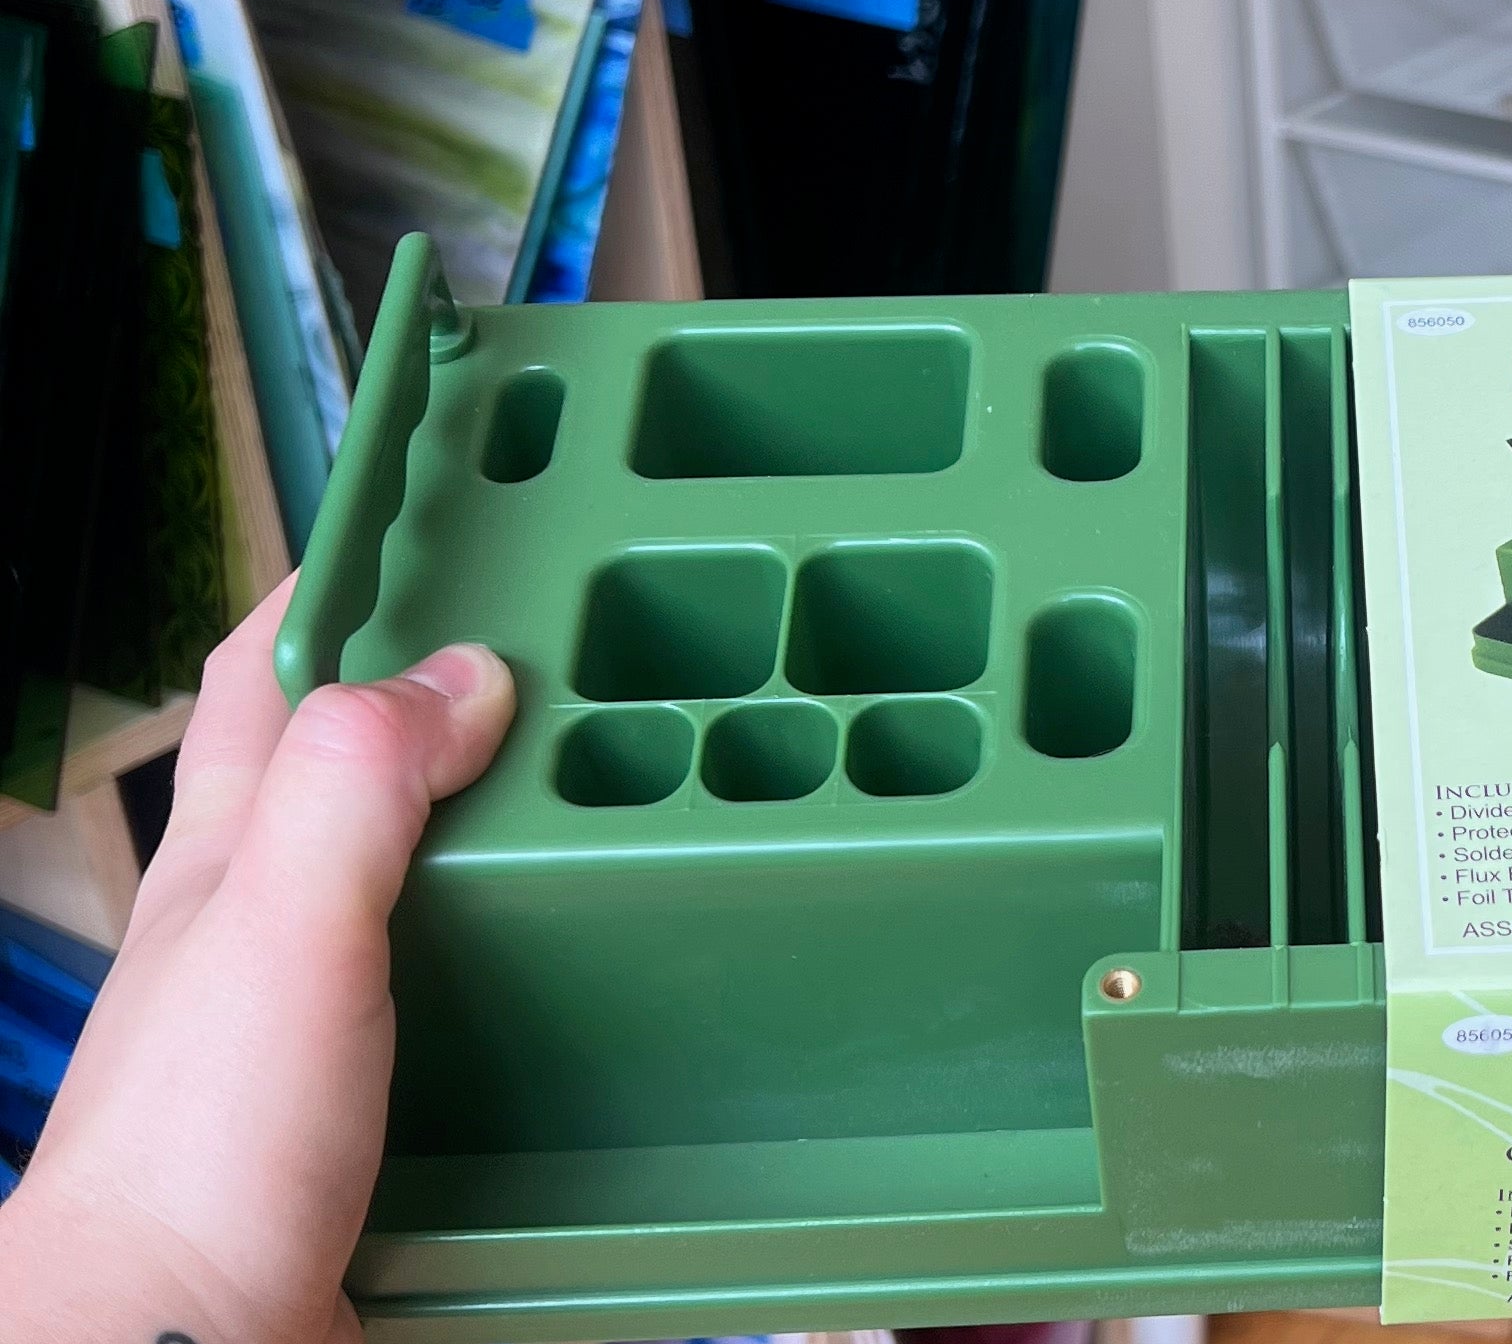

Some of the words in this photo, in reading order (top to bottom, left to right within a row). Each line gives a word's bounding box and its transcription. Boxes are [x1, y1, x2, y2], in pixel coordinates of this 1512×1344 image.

[1407, 315, 1466, 328] 856050
[1455, 868, 1501, 883] Flux
[1457, 889, 1496, 906] Foil
